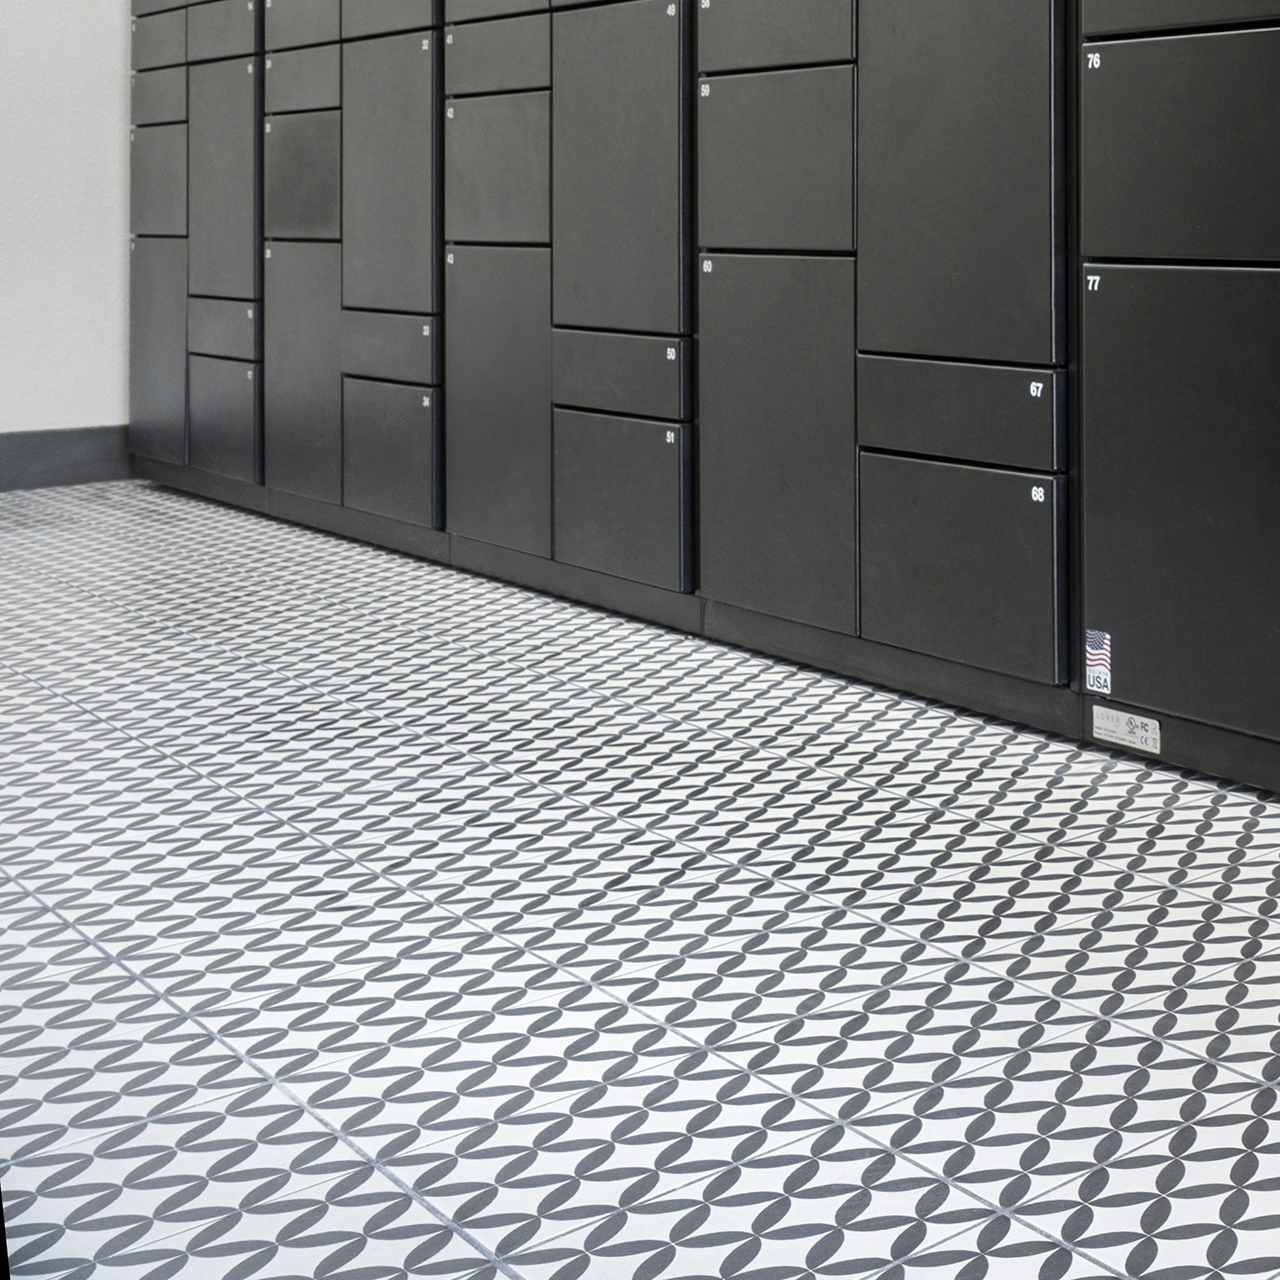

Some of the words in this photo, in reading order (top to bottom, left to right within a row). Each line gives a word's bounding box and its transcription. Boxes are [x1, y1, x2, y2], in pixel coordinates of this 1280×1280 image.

[1087, 52, 1101, 69] 76
[1086, 275, 1101, 291] 77
[1029, 381, 1044, 398] 67
[1031, 486, 1045, 503] 68
[1088, 674, 1109, 692] USA
